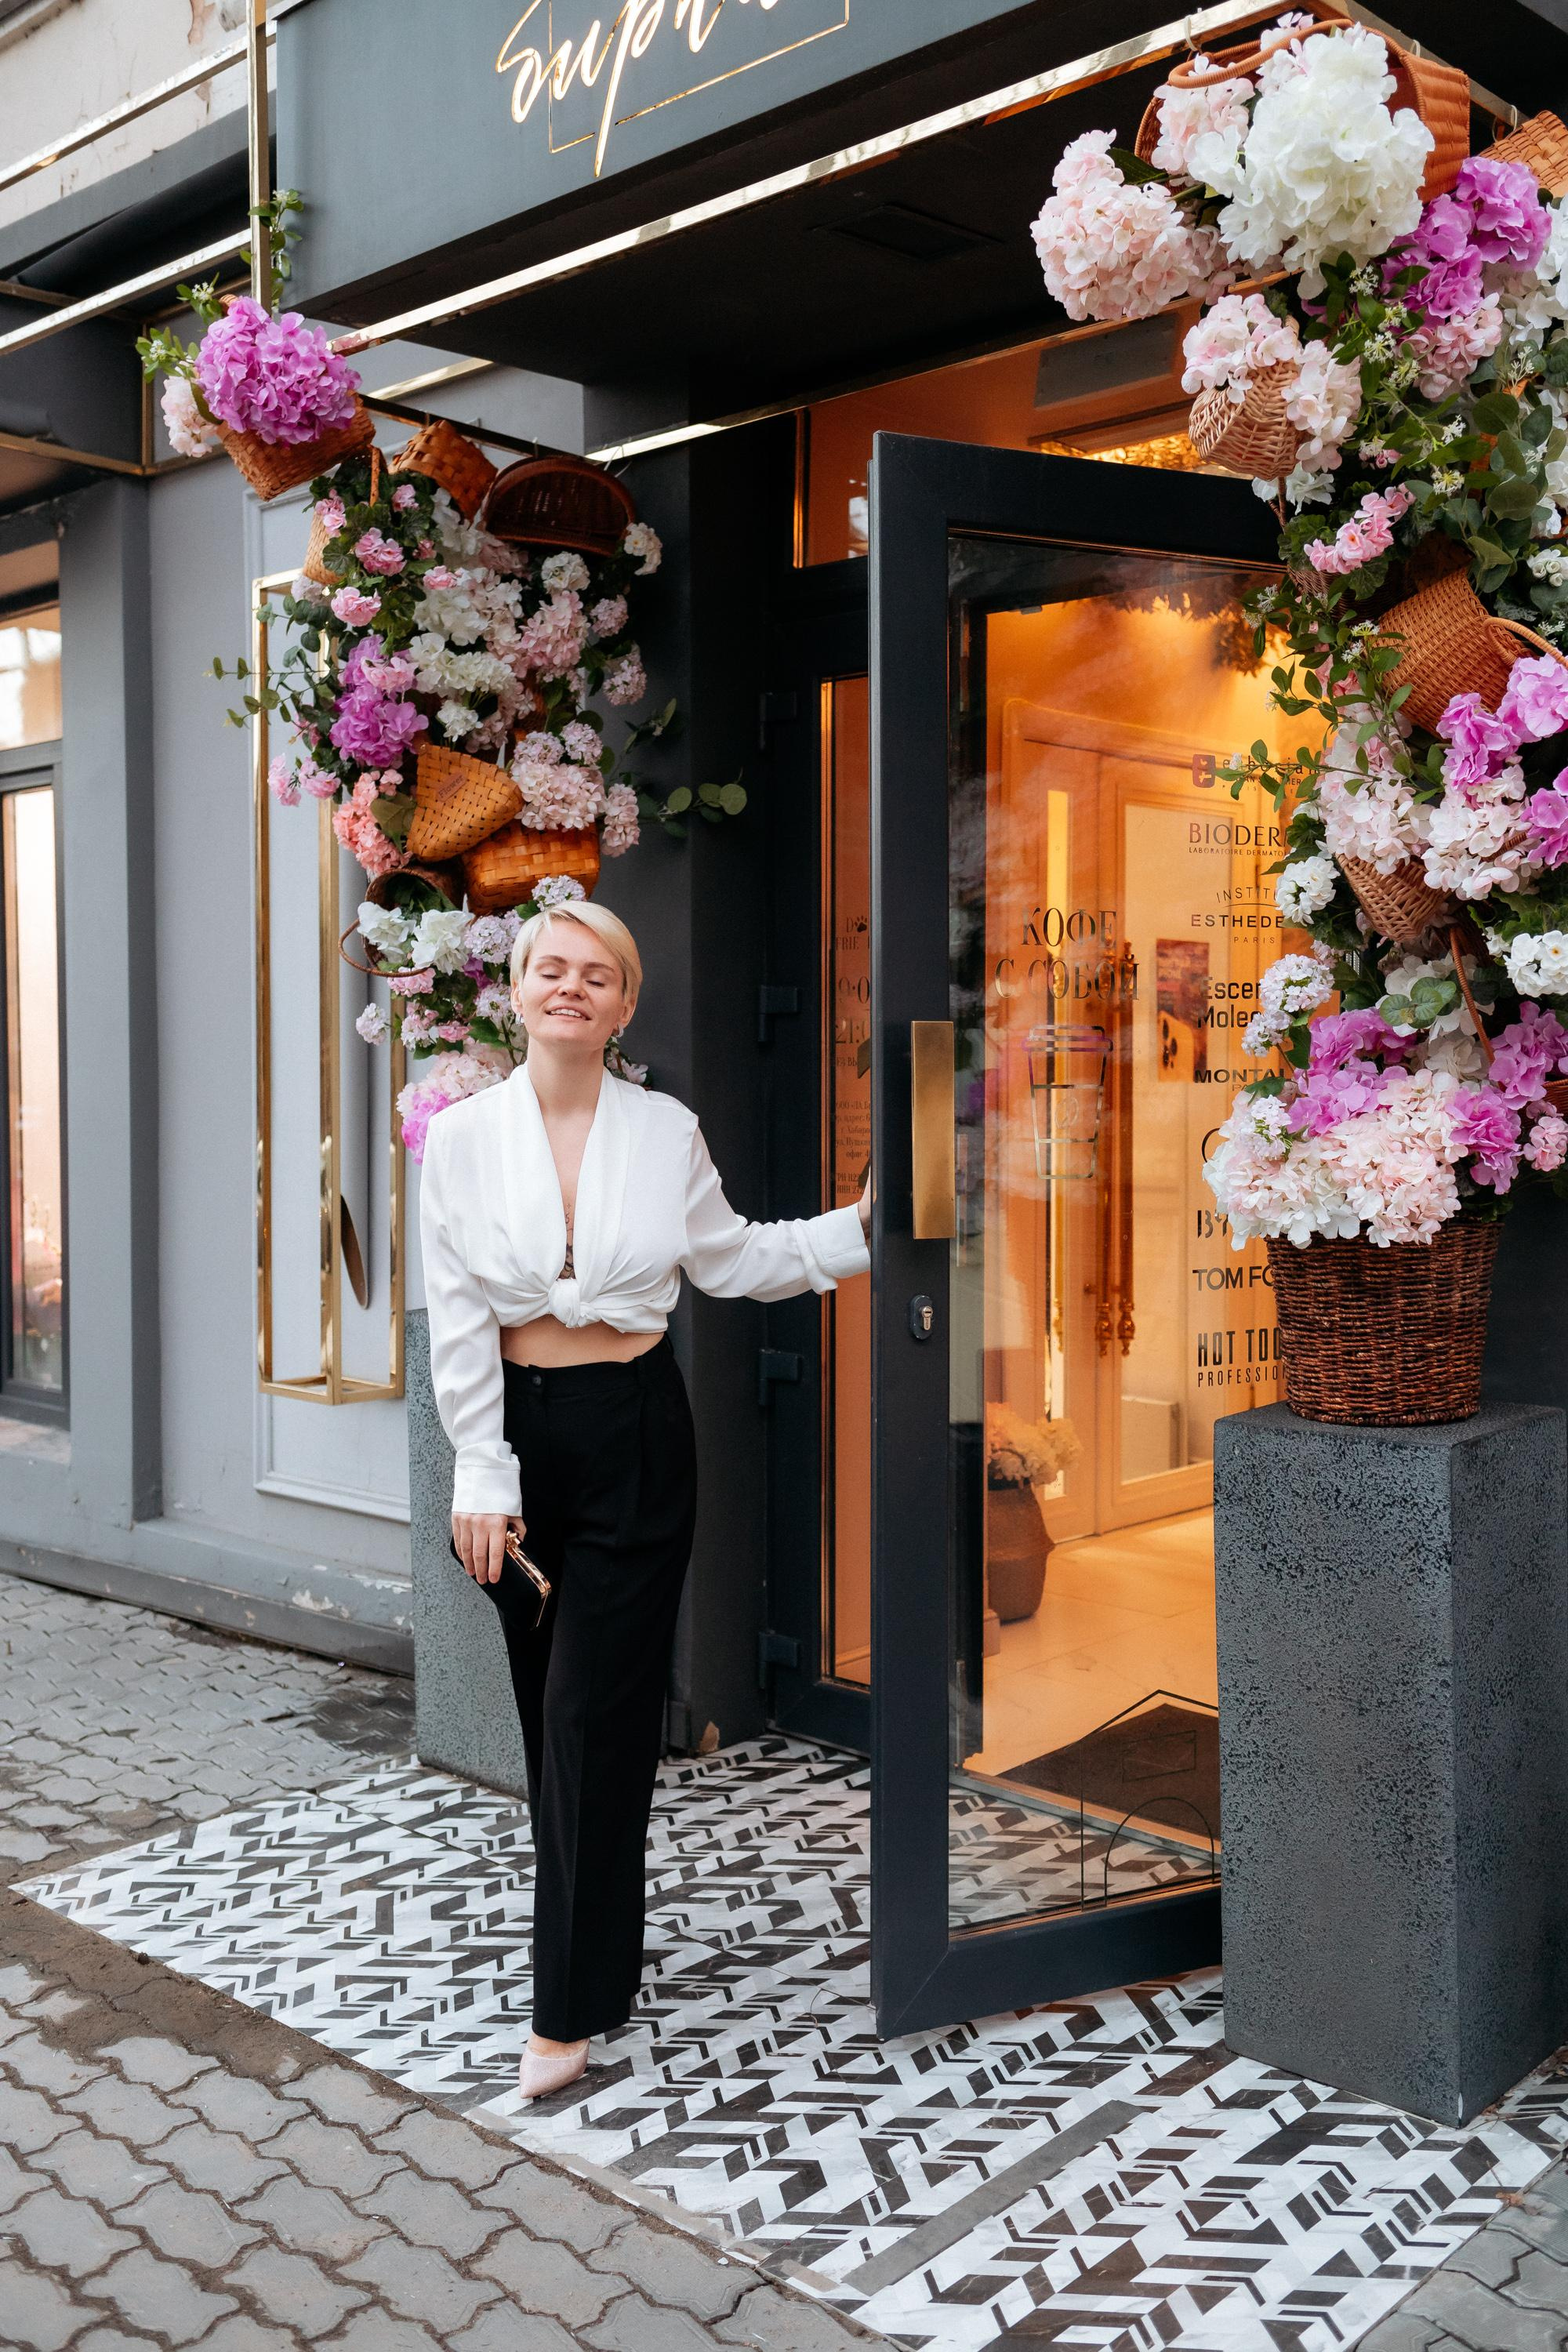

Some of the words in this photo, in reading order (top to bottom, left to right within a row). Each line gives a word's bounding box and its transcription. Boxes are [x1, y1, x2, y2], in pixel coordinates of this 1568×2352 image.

[1189, 822, 1287, 848] BIODER
[1216, 887, 1276, 903] INSTIT
[1022, 907, 1118, 949] КОФЕ
[1191, 913, 1286, 928] ESTHEDE
[1028, 953, 1141, 1001] СОБОЙ
[1192, 1267, 1243, 1291] TOM
[1249, 1265, 1274, 1288] FO
[1198, 1330, 1236, 1367] HOT
[1245, 1327, 1283, 1363] TOO
[1198, 1365, 1287, 1388] PROFESSIO
